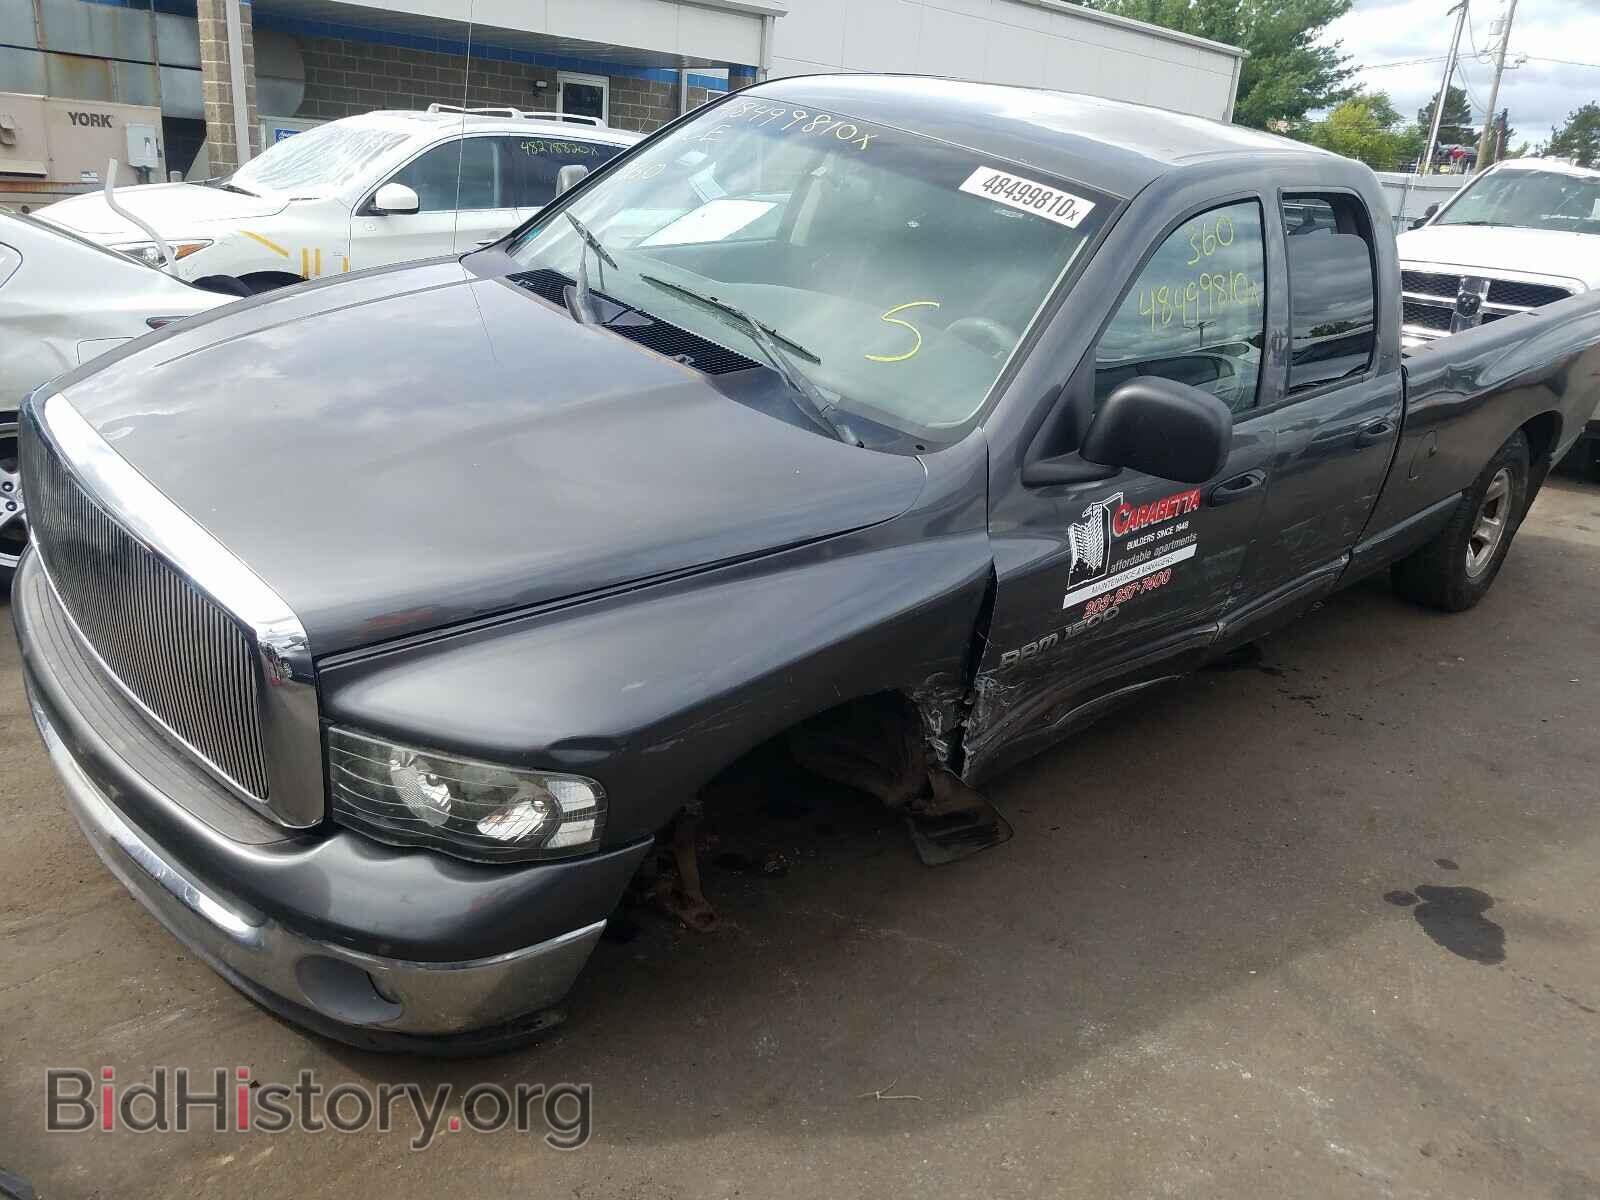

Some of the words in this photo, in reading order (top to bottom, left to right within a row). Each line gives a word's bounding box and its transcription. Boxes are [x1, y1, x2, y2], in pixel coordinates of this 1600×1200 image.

[67, 111, 113, 129] YORK
[1185, 215, 1234, 266] 360
[1112, 488, 1200, 537] CARABETTA
[1109, 550, 1152, 574] affordable
[1153, 532, 1198, 557] apartments
[1126, 533, 1156, 551] BUILDERS
[1156, 526, 1175, 540] SINCE
